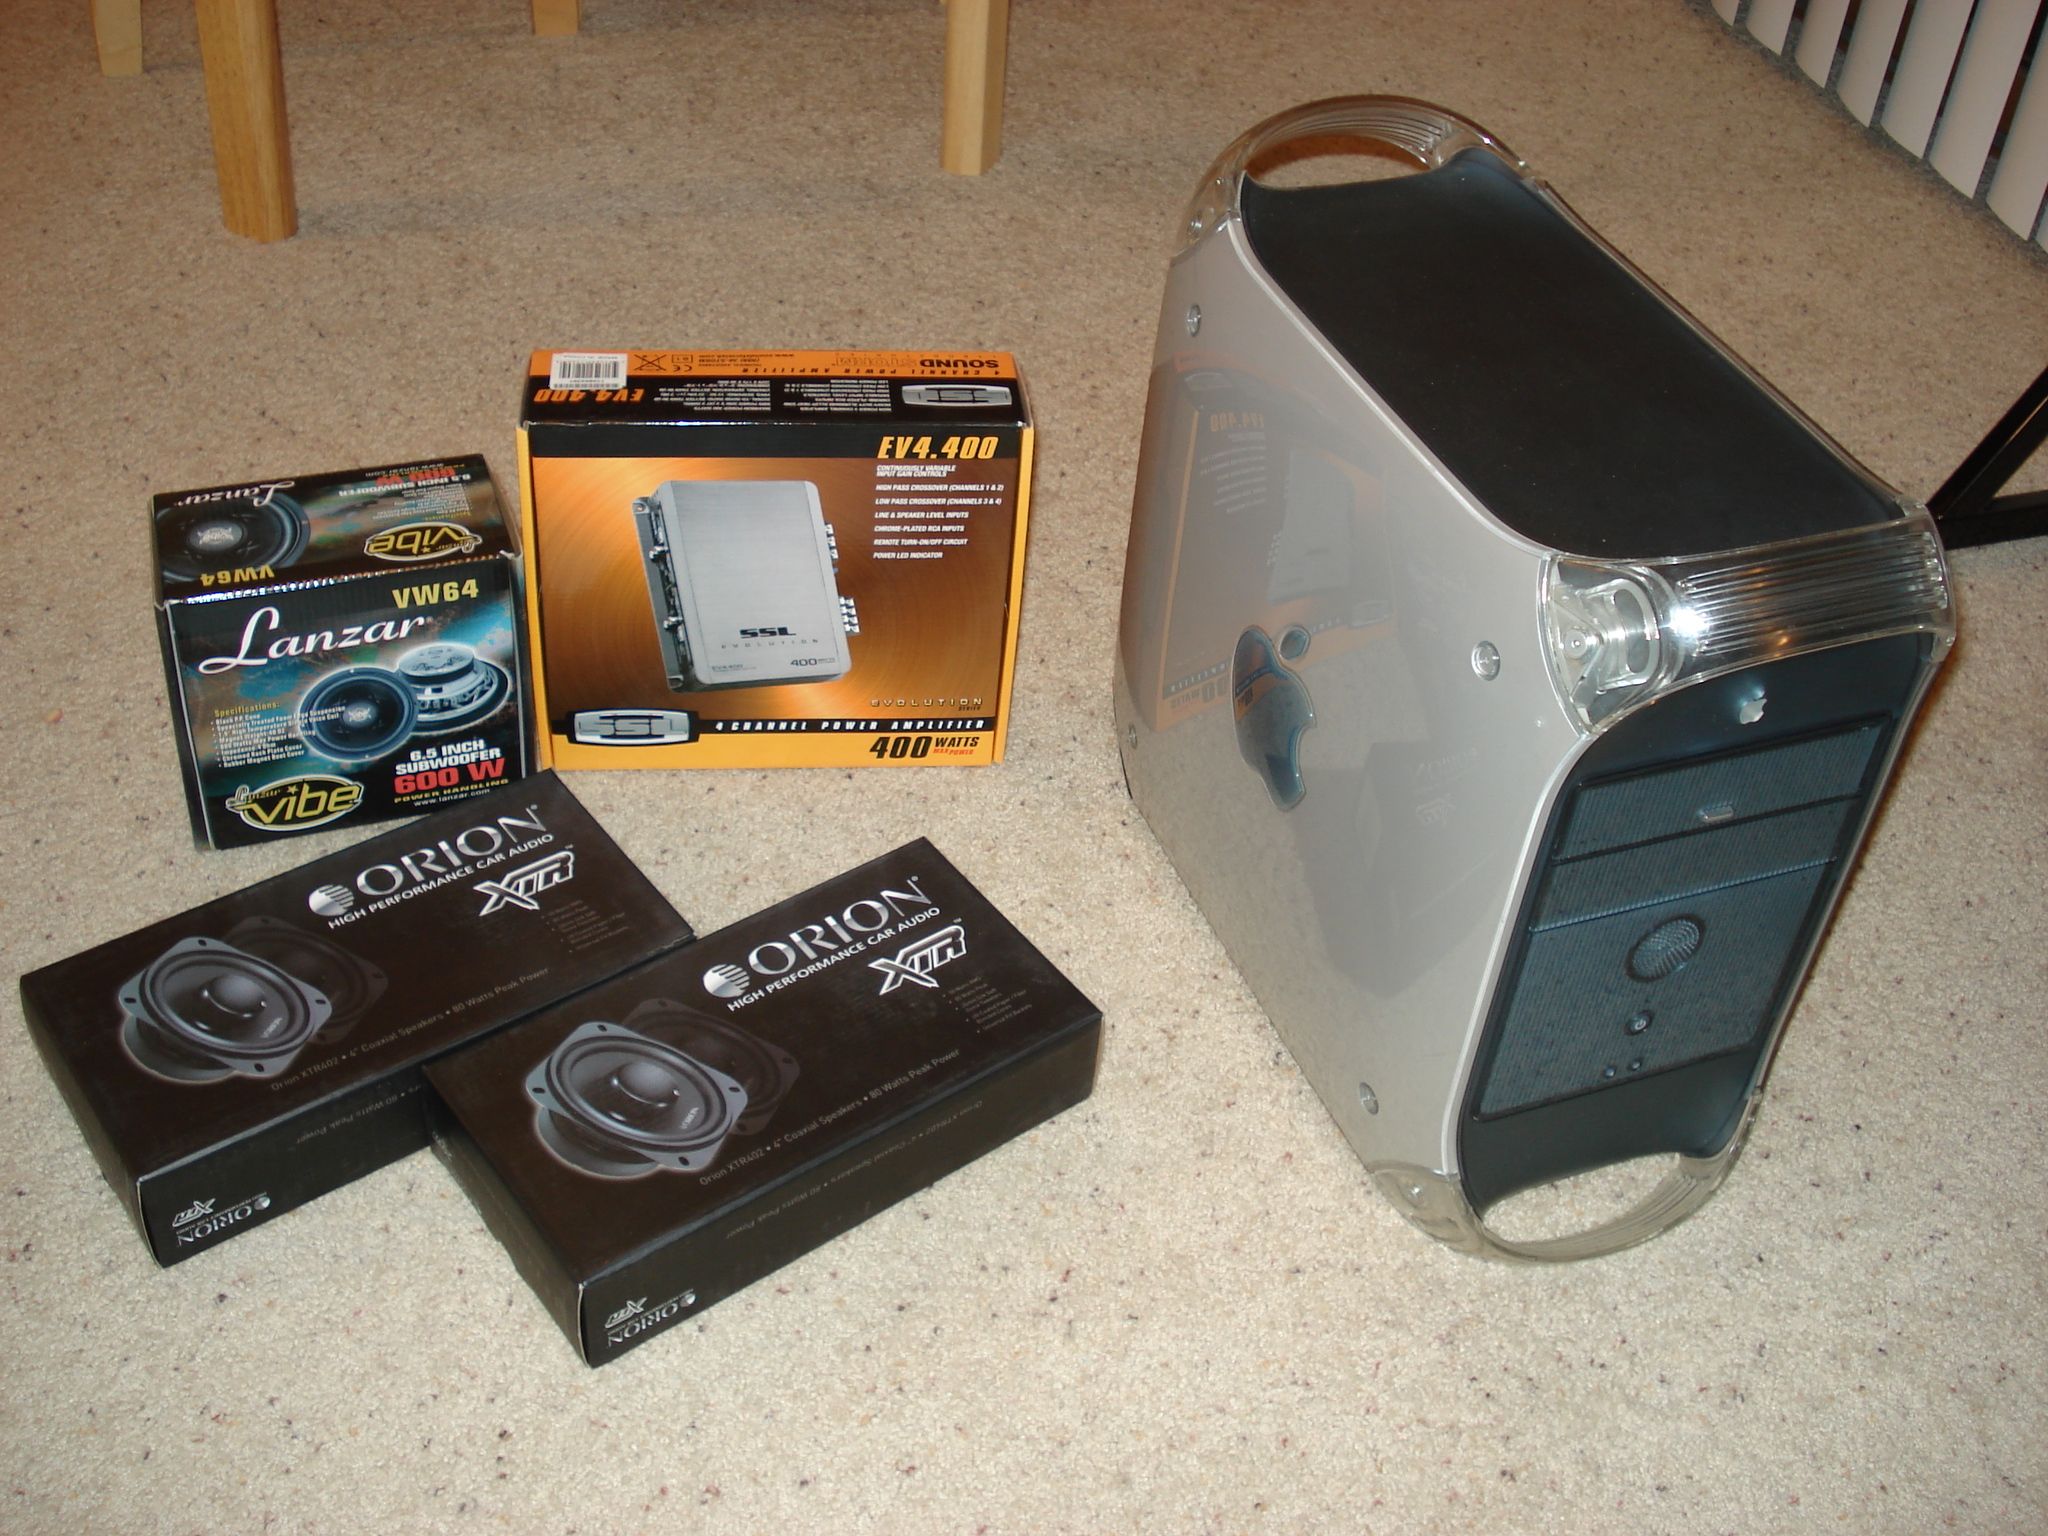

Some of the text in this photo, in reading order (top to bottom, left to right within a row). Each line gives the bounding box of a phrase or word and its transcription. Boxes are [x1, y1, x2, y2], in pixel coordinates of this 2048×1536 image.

[919, 358, 1000, 369] SOUND
[877, 435, 999, 459] EV4.400
[417, 476, 449, 487] INCH
[876, 464, 956, 472] CONTINUOUSLY VARIABLE
[176, 480, 295, 508] Lanzar
[338, 479, 416, 497] SUBWOOFER
[368, 527, 475, 555] vibe
[200, 564, 275, 587] VW64
[391, 578, 479, 609] VW64
[198, 606, 426, 675] Lanzar
[739, 626, 796, 639] SSL
[869, 697, 983, 708] EVOLUTION
[714, 719, 985, 731] 4 CHANNEL POWER AMPLIFIER
[395, 747, 502, 775] SUBWOOFER
[410, 738, 485, 762] 6.5 INCH
[869, 735, 980, 759] 400 WATTS
[394, 757, 505, 794] 600 W
[233, 782, 361, 825] vibe
[394, 778, 509, 804] POWER HANDLING
[413, 788, 490, 807] www.lanzar.com
[357, 808, 547, 896] ORION
[328, 834, 555, 930] HIGH PERFORMANCE CAR AUDIO
[748, 879, 932, 976] ORION
[727, 907, 941, 1012] HIGH PERFORMANCE CAR AUDIO
[361, 1031, 398, 1053] Coaxial
[398, 1013, 445, 1037] Speakers
[465, 990, 494, 1008] Watts
[494, 979, 519, 996] Peak
[519, 967, 550, 985] Power
[699, 1168, 728, 1187] Orion
[728, 1148, 766, 1172] XTR402
[783, 1121, 820, 1144] Coaxial
[819, 1099, 864, 1127] Speakers
[869, 1088, 882, 1100] 80
[881, 1076, 909, 1093] Watts
[909, 1064, 933, 1081] Peak
[932, 1048, 961, 1068] Power
[177, 1207, 252, 1247] ORION
[607, 1303, 678, 1347] ORION
